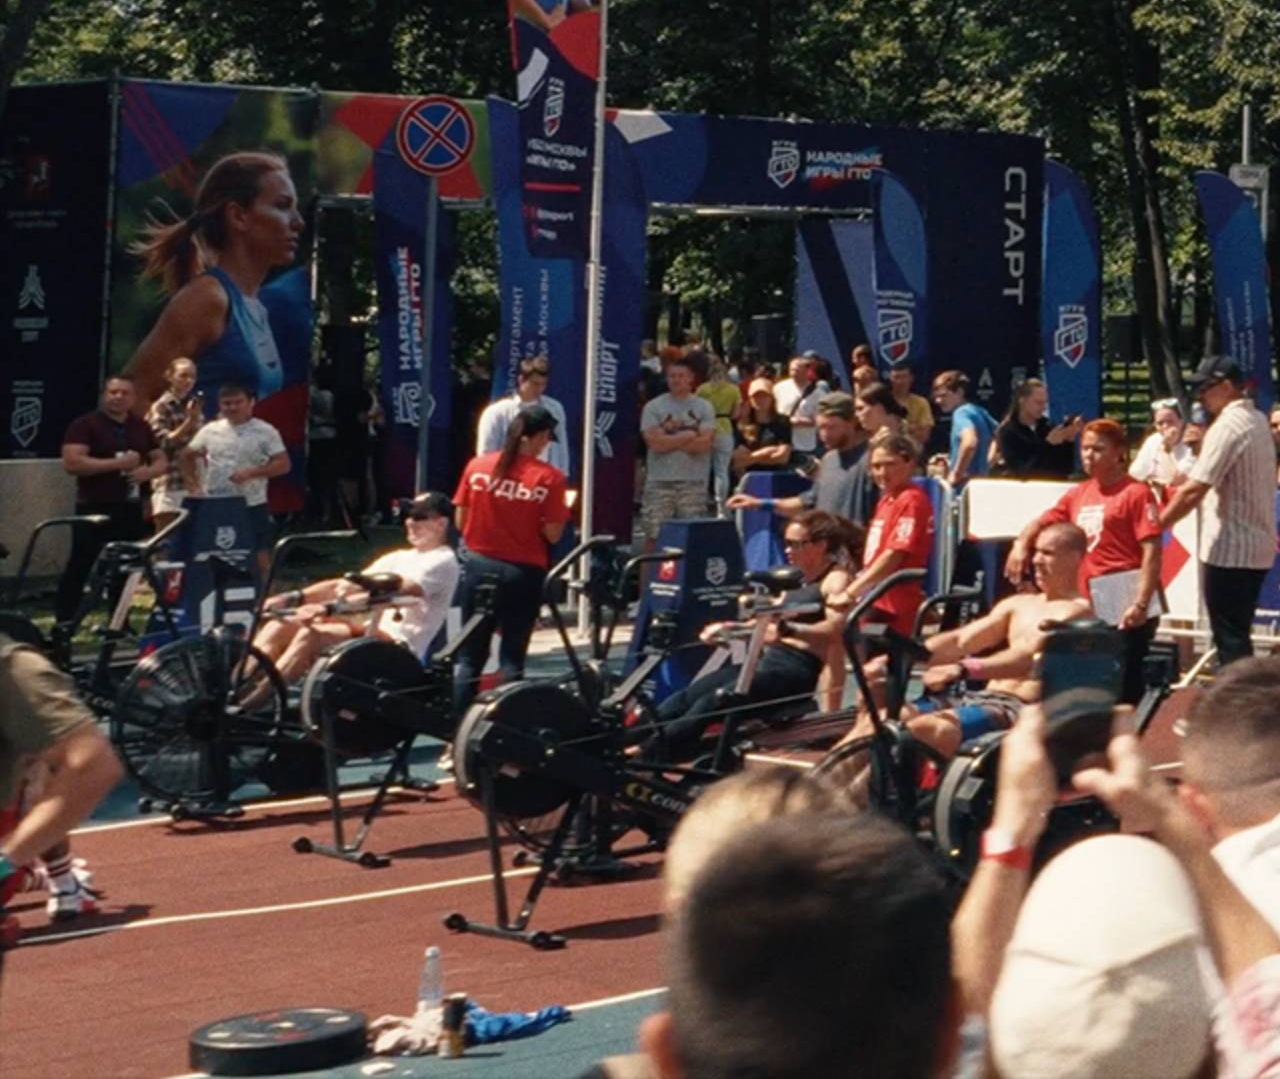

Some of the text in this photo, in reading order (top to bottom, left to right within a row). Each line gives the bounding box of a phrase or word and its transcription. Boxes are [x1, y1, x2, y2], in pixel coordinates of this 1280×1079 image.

[1003, 167, 1027, 305] СТАРТ
[397, 246, 411, 370] НАРОДНЫЕ
[411, 264, 421, 302] ГТО
[601, 340, 620, 403] СПОРТ
[469, 473, 549, 503] СУДЬЯ
